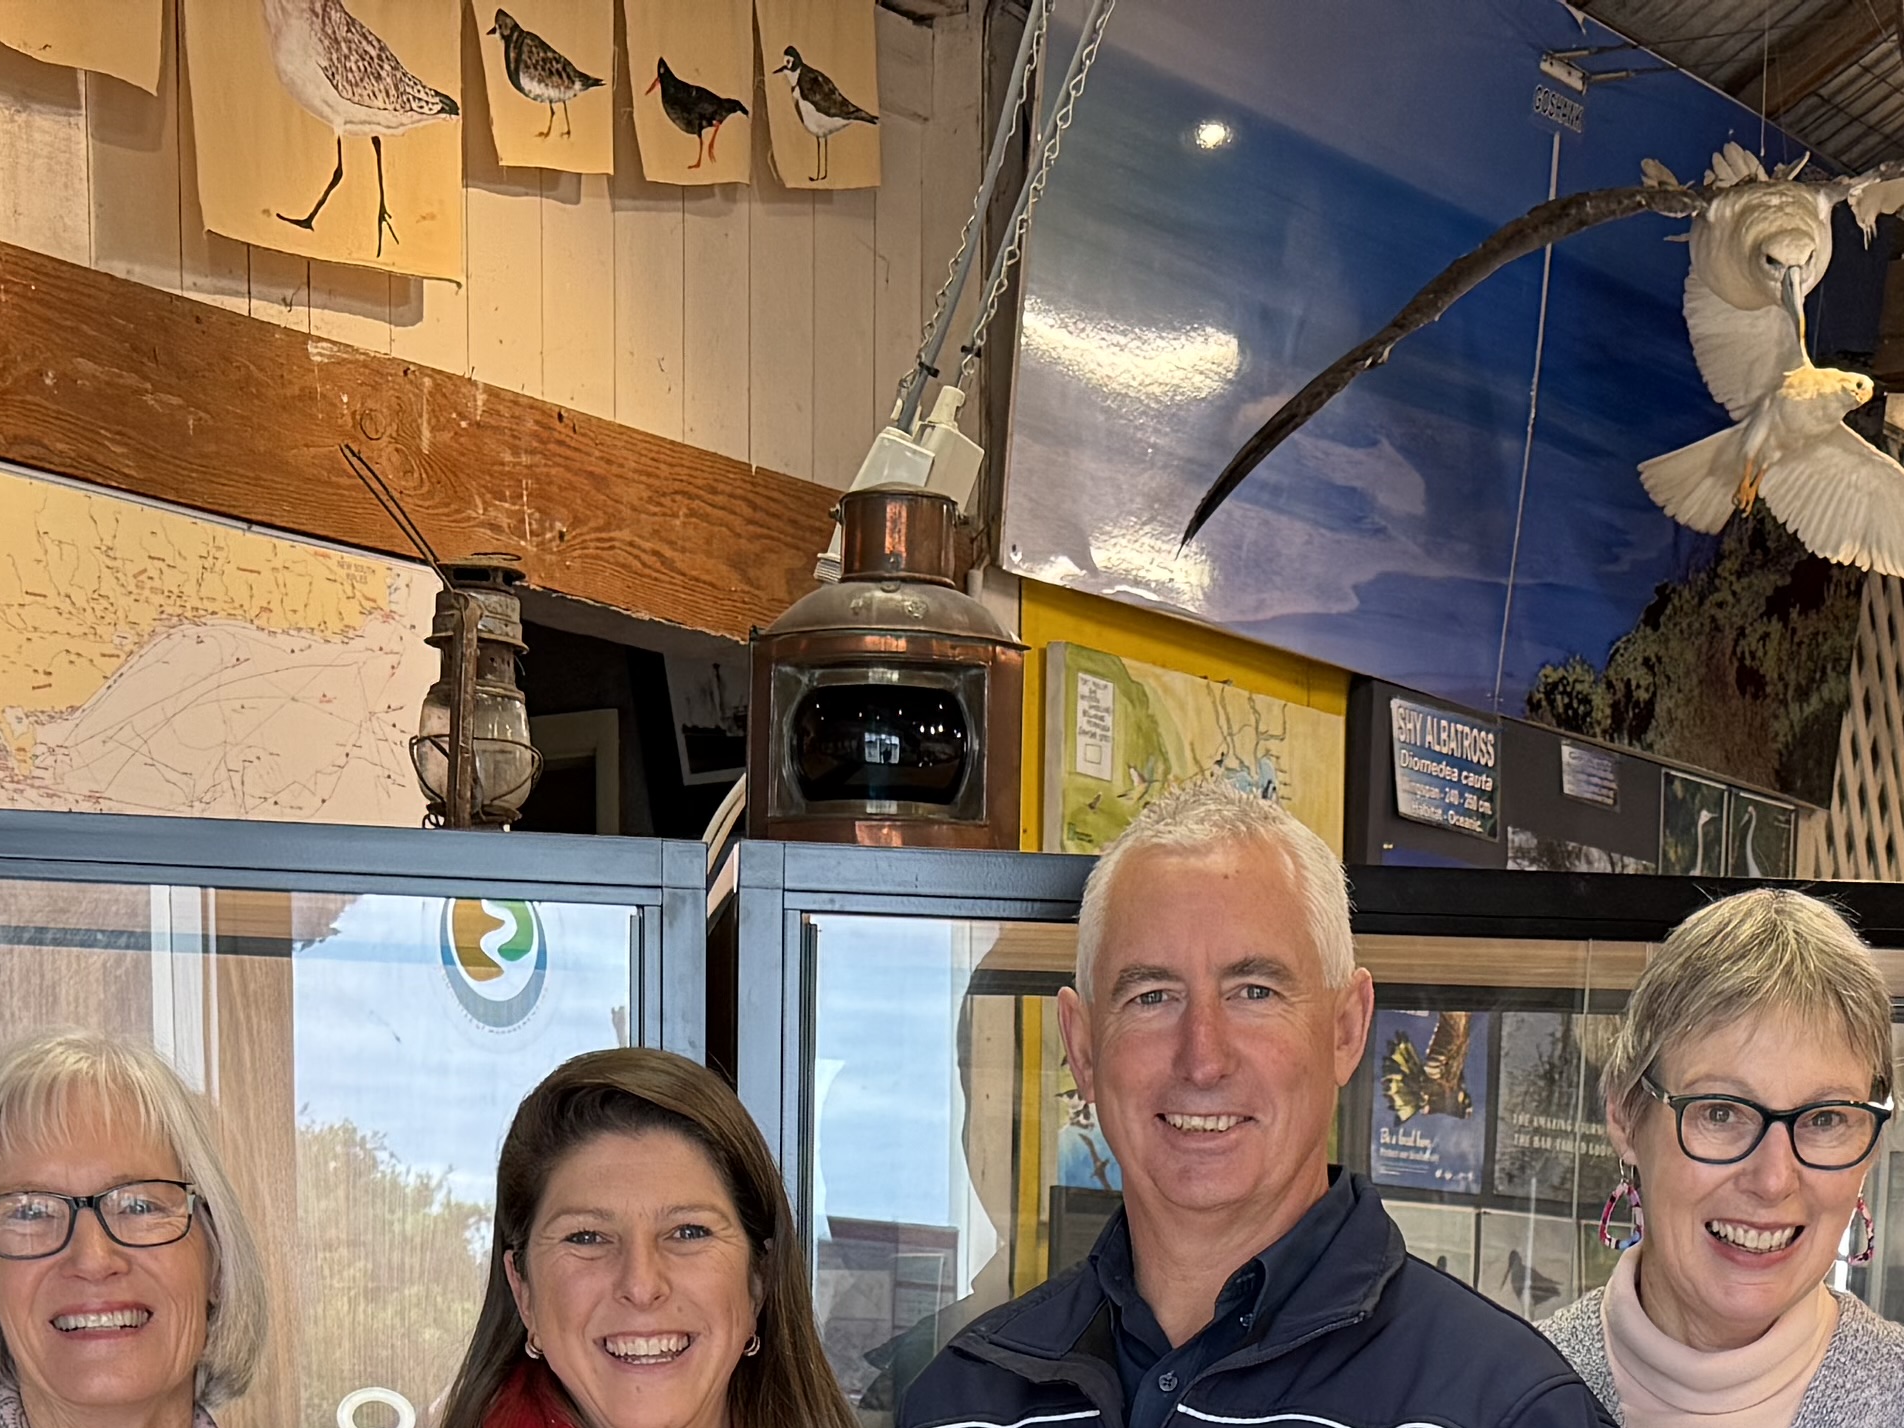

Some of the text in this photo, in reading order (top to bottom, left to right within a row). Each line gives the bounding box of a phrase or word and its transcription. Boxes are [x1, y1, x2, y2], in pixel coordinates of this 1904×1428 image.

[1534, 84, 1584, 133] GOSHAWK
[1397, 704, 1495, 768] SHY ALBATROSS
[1399, 749, 1493, 792] Diomedea cauta
